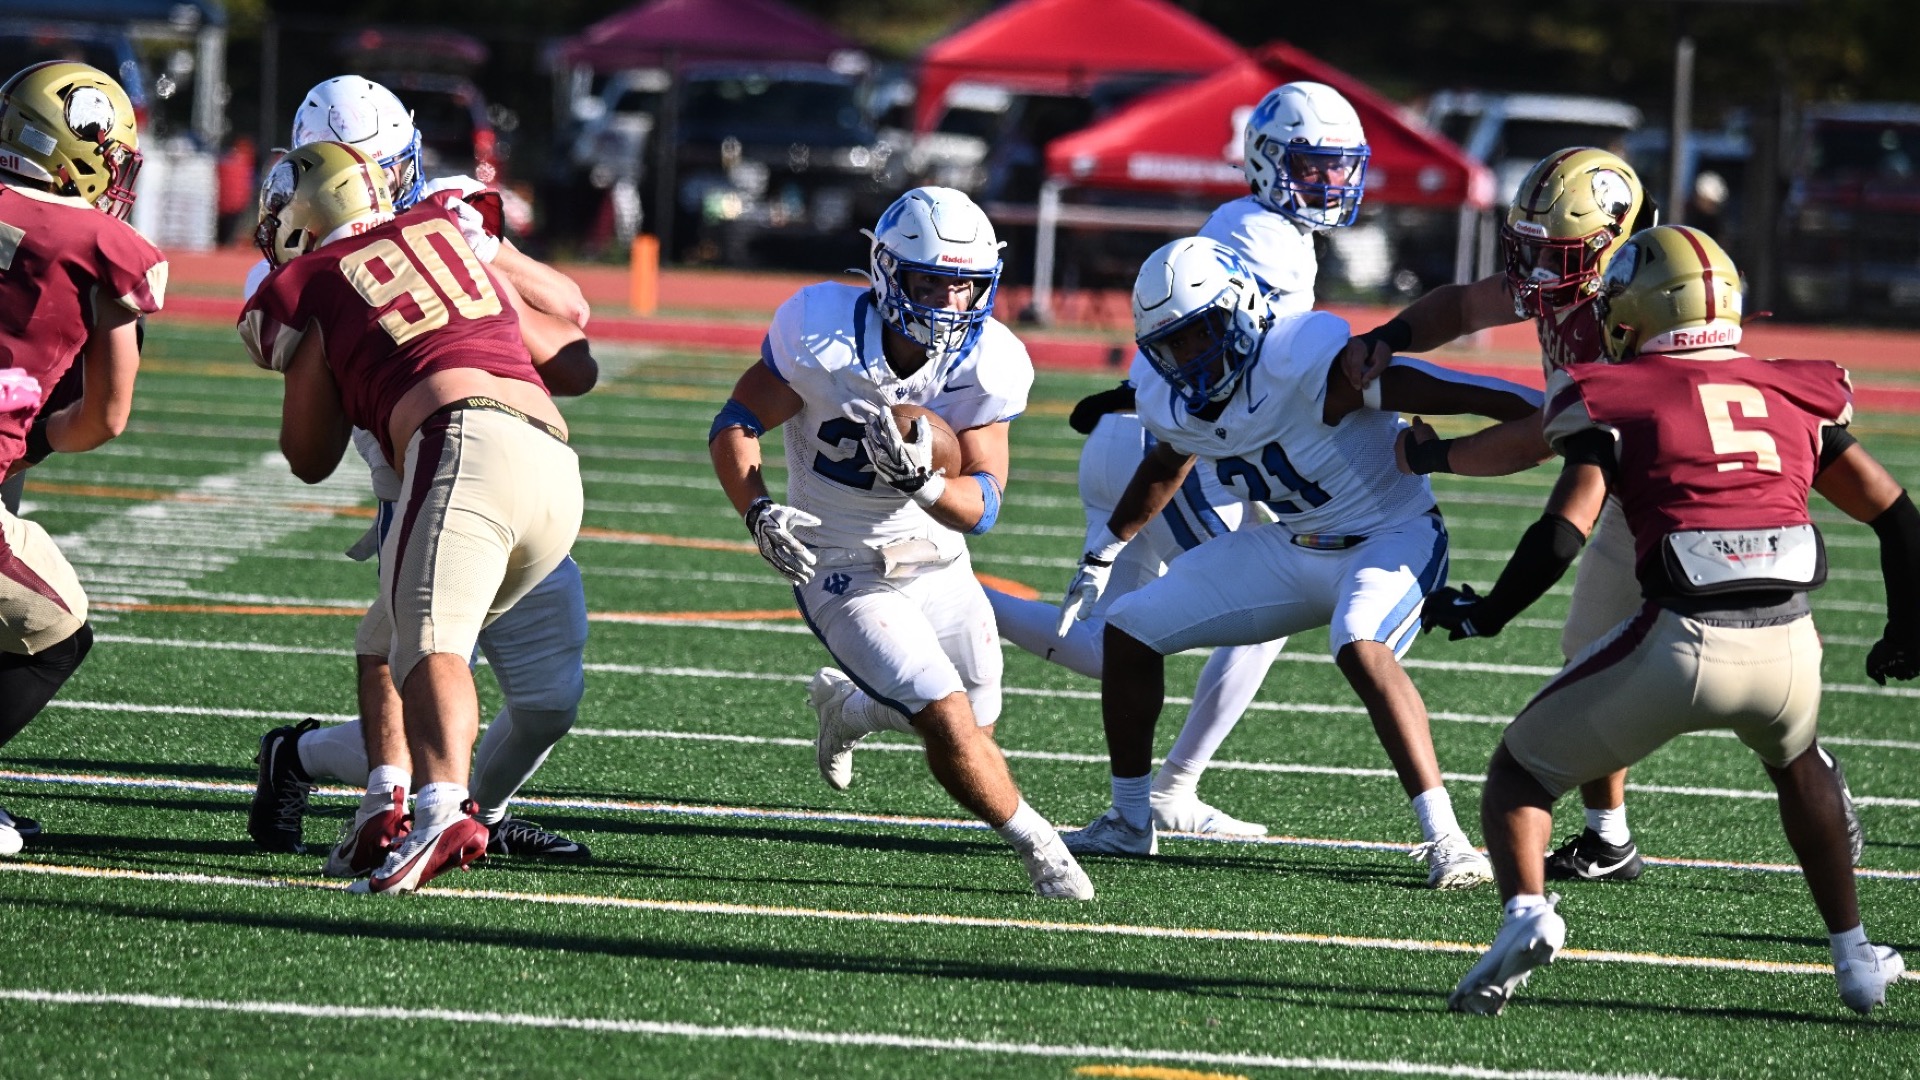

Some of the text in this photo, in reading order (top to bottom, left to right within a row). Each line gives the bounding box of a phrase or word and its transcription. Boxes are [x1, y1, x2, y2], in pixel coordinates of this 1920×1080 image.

[942, 254, 973, 264] Riddell
[339, 218, 503, 346] 90
[1673, 328, 1735, 346] Riddell
[467, 398, 500, 408] BUCK
[1697, 383, 1782, 473] 5
[1215, 441, 1333, 514] 21
